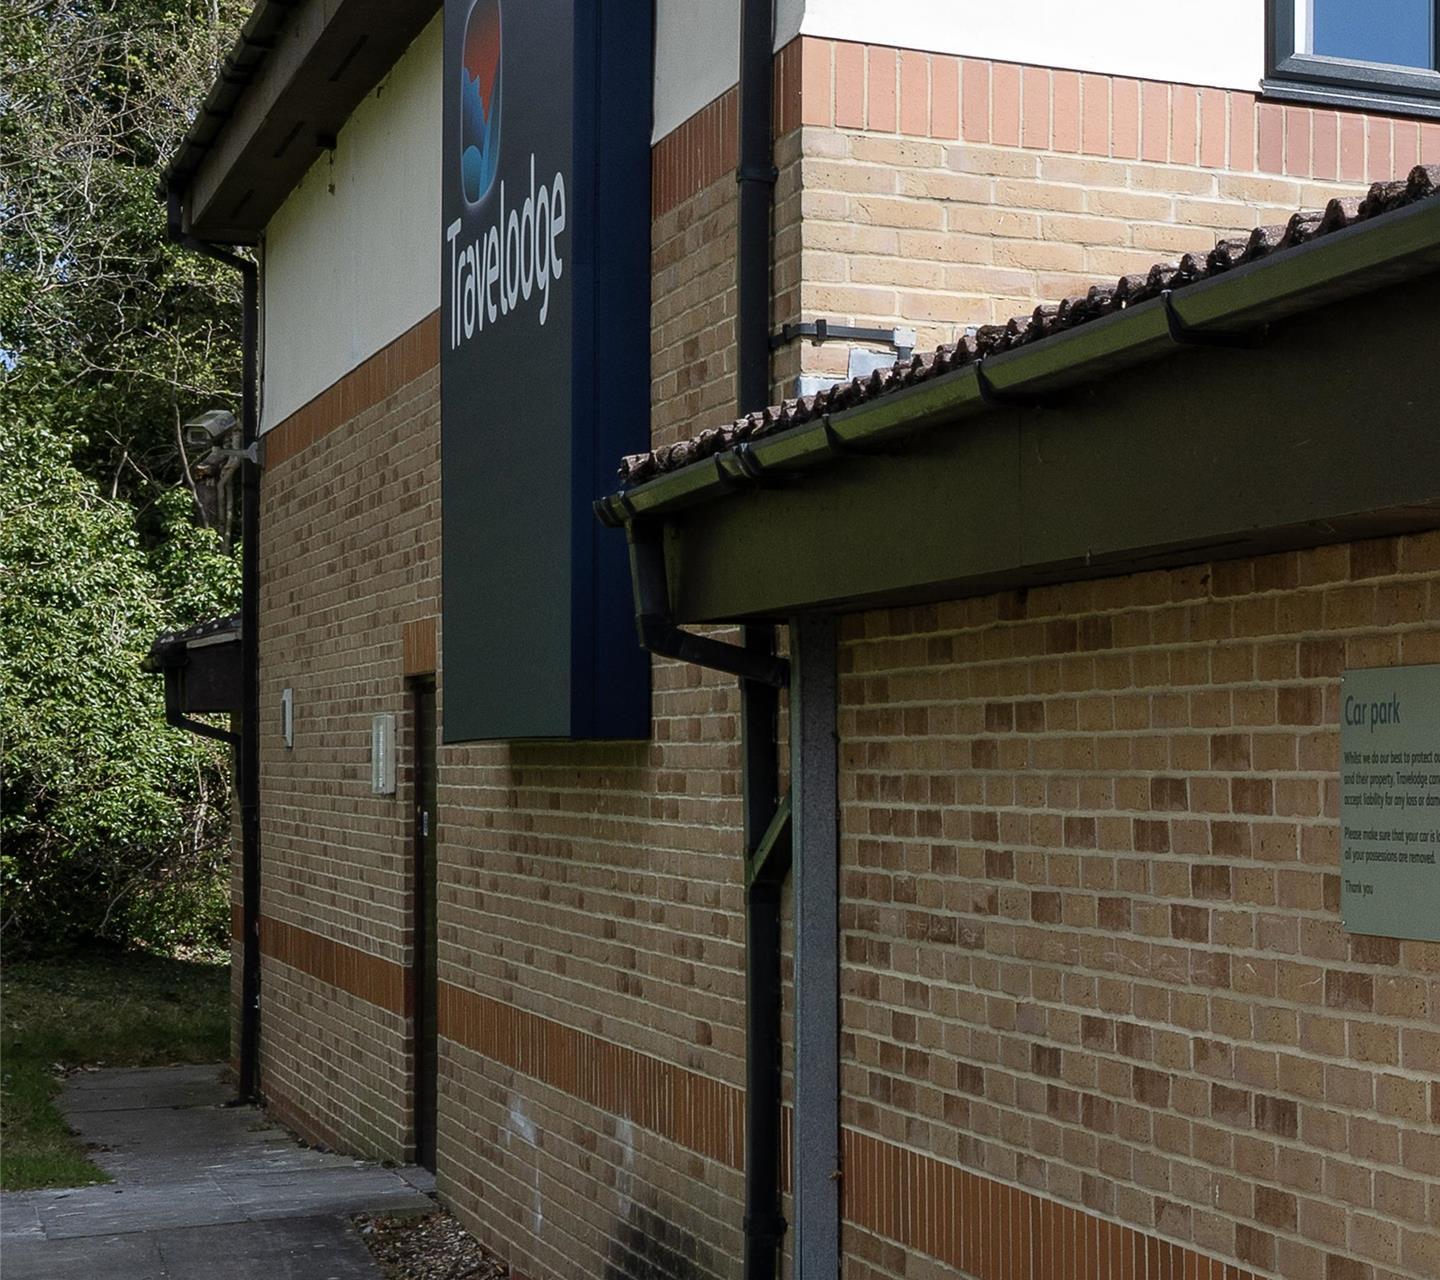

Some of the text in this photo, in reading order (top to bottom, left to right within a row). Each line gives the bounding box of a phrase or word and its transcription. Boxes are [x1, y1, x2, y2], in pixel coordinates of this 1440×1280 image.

[447, 153, 566, 352] Travelodge
[1345, 693, 1400, 733] Car park
[1391, 751, 1402, 763] best
[1411, 752, 1433, 766] protect
[1344, 772, 1354, 784] and
[1396, 772, 1427, 788] Travelodge
[1344, 793, 1362, 808] accept
[1395, 796, 1405, 809] any
[1406, 793, 1417, 806] loss
[1345, 826, 1361, 840] Please
[1363, 828, 1378, 840] make
[1392, 828, 1404, 841] that
[1405, 832, 1418, 845] your
[1352, 851, 1364, 863] your
[1366, 850, 1397, 864] possessions
[1345, 880, 1373, 897] Thank you
